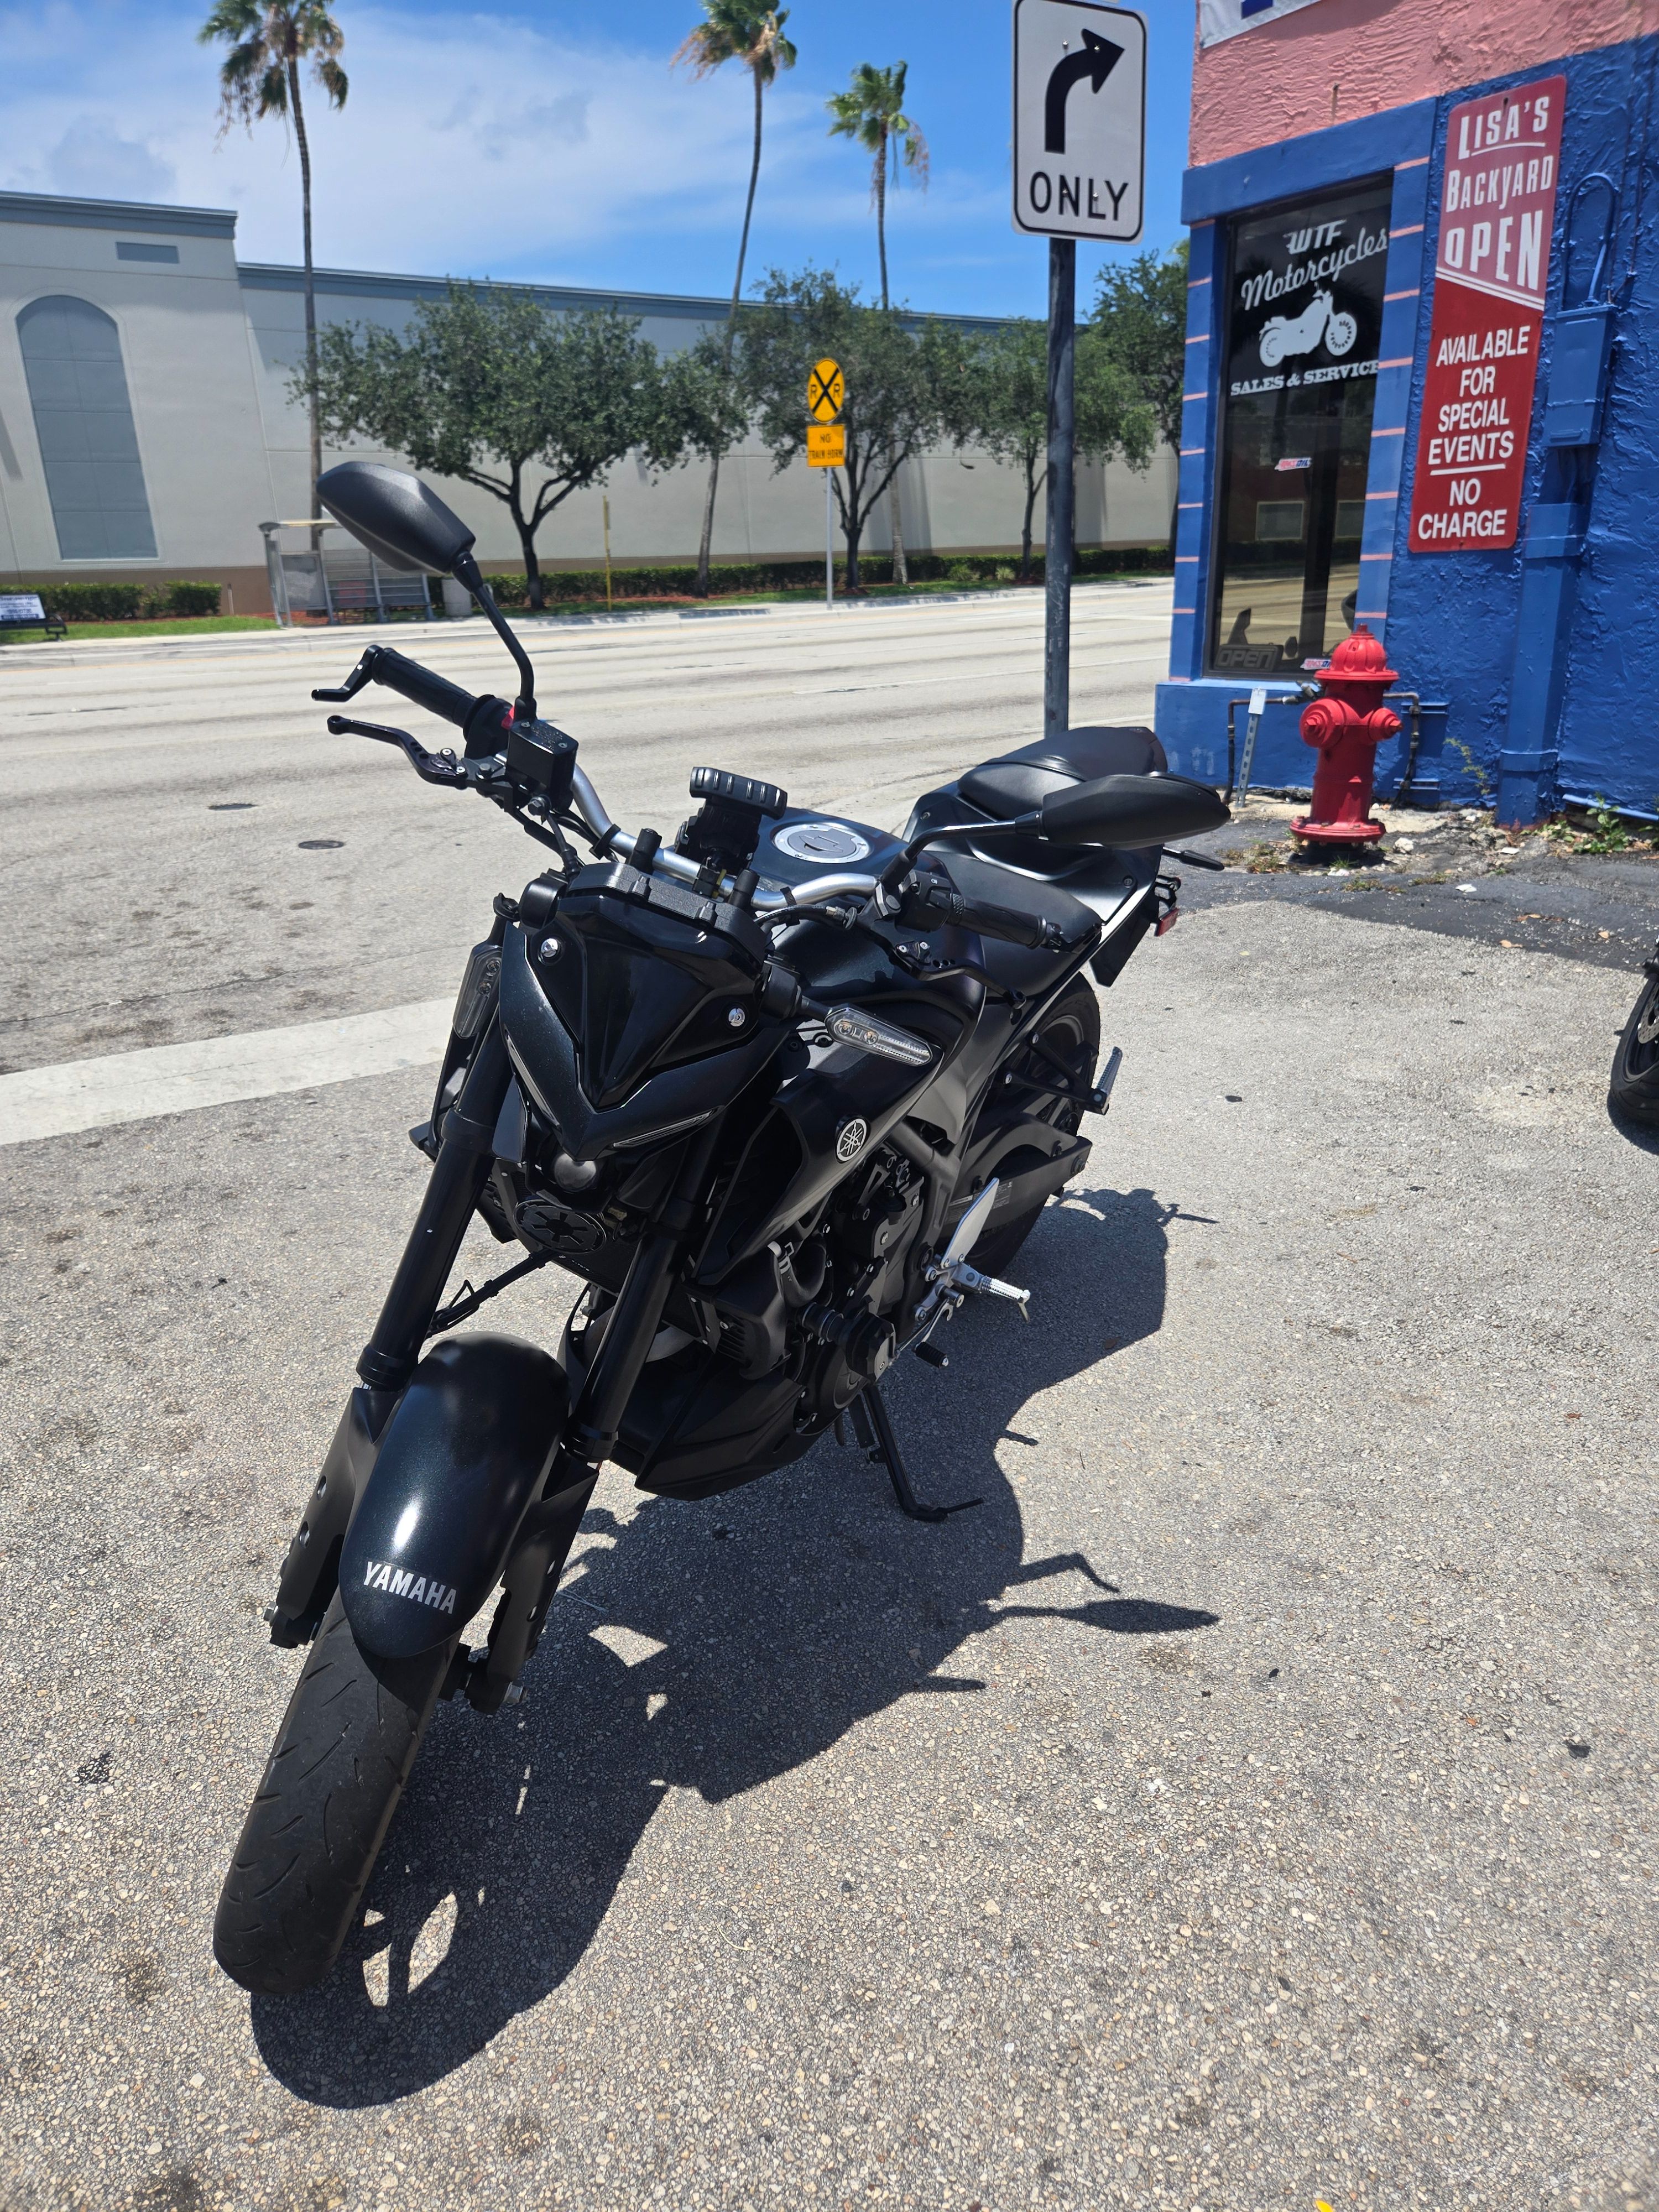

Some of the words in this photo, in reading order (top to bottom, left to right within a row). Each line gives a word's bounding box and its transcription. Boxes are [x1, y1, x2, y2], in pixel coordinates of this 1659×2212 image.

[1030, 171, 1129, 221] ONLY
[1283, 219, 1347, 254] WTF
[1444, 210, 1543, 291] OPEN
[1241, 227, 1388, 311] Motorcycles
[1436, 325, 1530, 367] AVAILABLE
[1230, 374, 1285, 397] SALES
[1286, 373, 1301, 387] &
[1303, 359, 1380, 385] SERVICE
[1459, 366, 1496, 398] FOR
[1438, 397, 1510, 433] SPECIAL
[1428, 430, 1515, 465] EVENTS
[1449, 478, 1481, 507] NO
[1418, 509, 1507, 540] CHARGE
[1217, 649, 1274, 669] OPEN
[363, 1561, 457, 1615] YAMAHA
